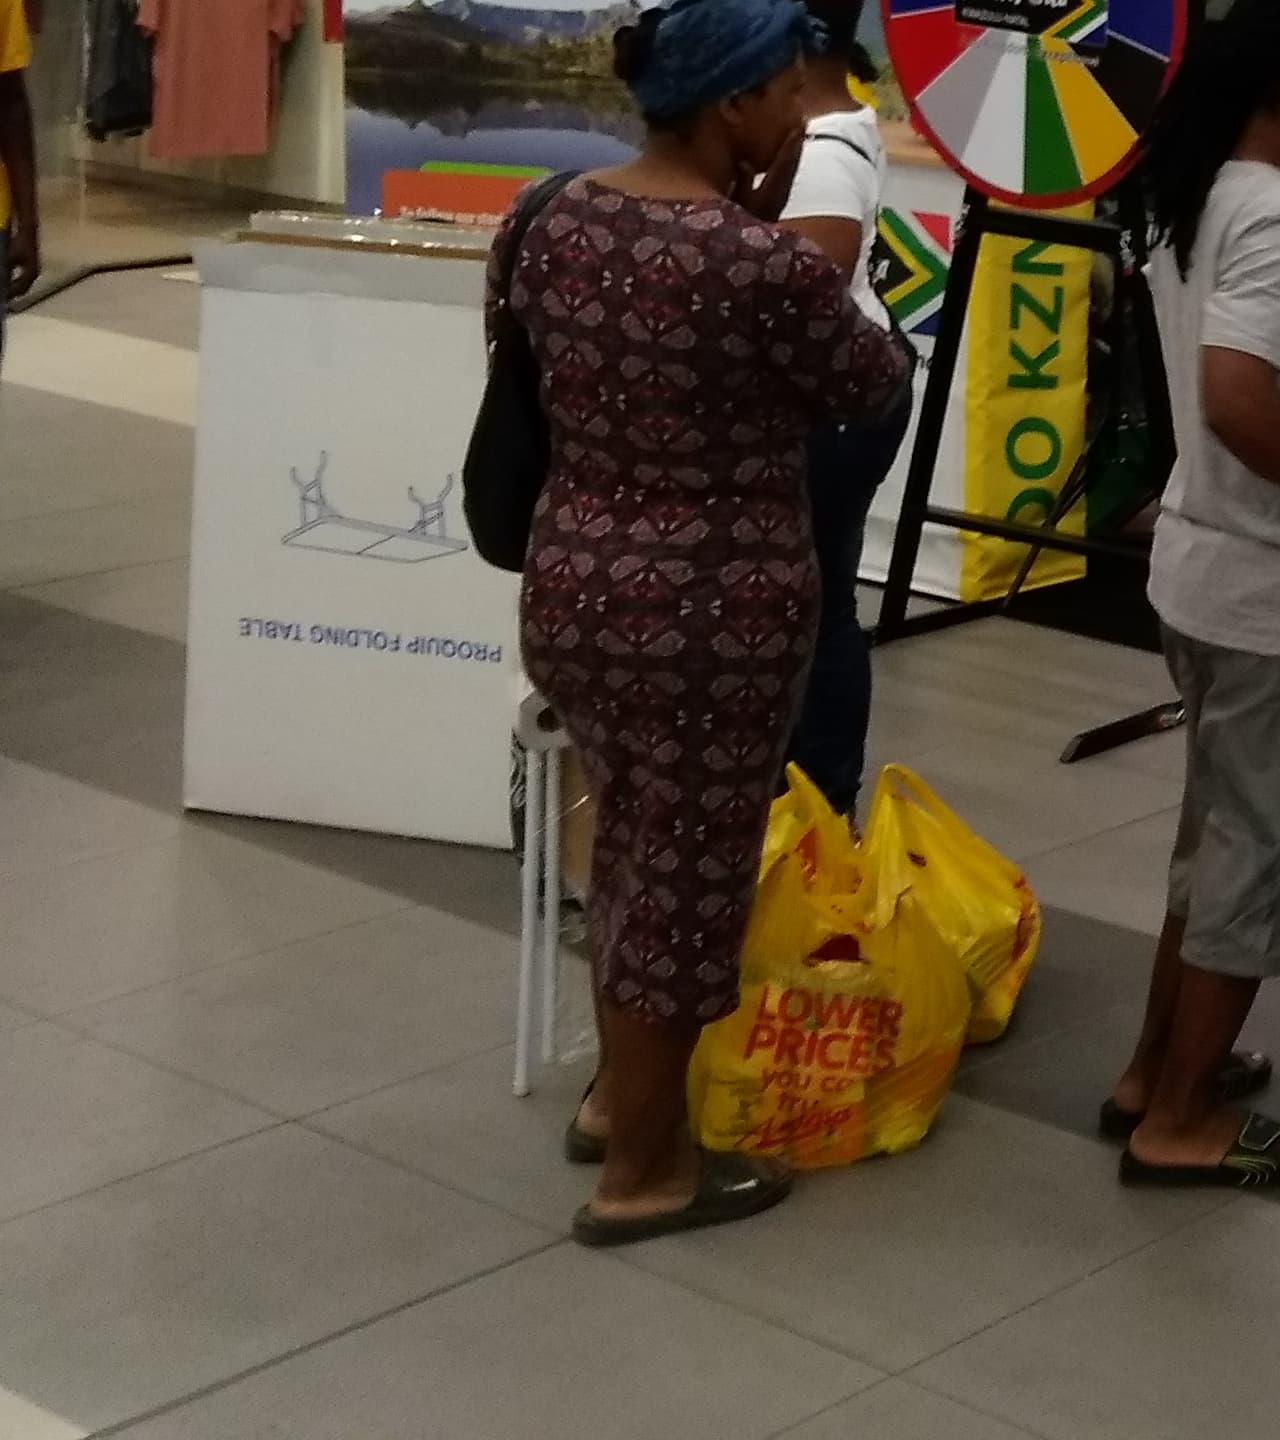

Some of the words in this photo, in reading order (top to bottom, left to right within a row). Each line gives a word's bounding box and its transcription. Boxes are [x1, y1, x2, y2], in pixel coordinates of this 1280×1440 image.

[239, 616, 303, 643] TABLE
[310, 624, 401, 652] FOLDING
[404, 635, 502, 663] PROQUIP
[755, 984, 904, 1039] LOWER
[742, 1022, 900, 1074] PRICES
